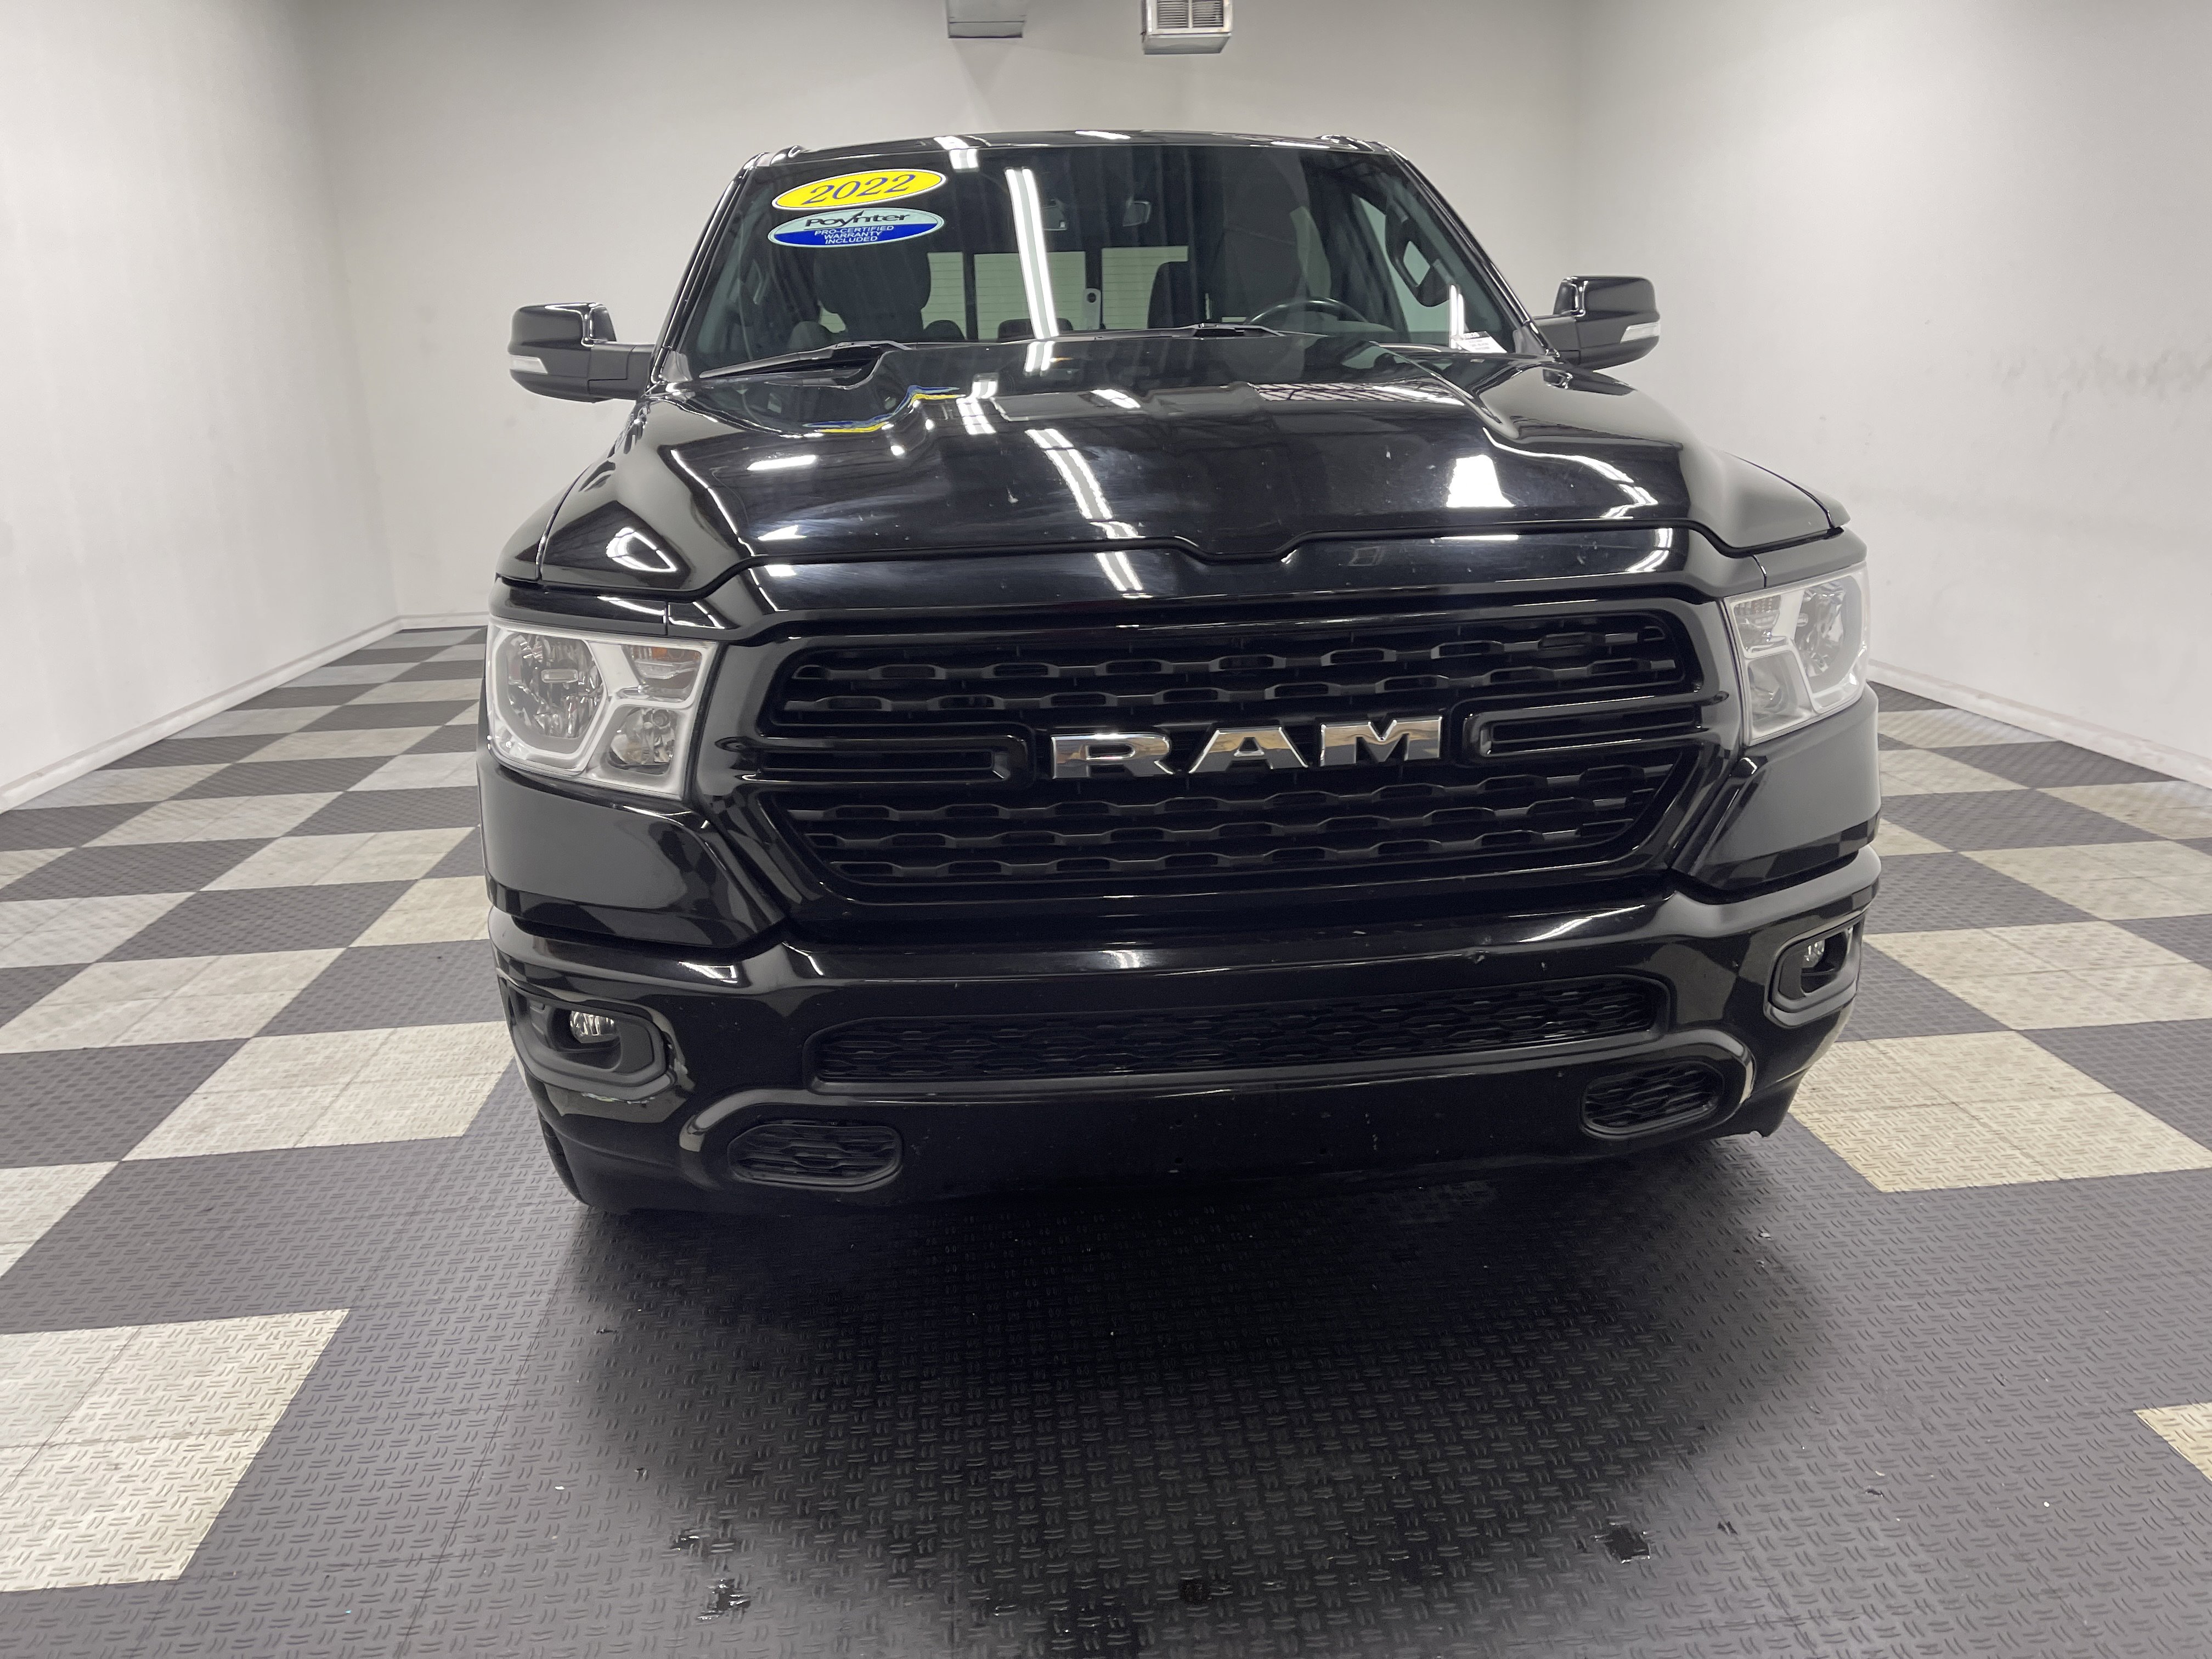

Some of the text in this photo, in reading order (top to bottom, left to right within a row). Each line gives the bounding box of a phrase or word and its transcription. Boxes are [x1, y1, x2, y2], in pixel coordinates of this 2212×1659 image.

[801, 174, 916, 205] 2022
[804, 210, 911, 230] Poynter
[814, 225, 894, 236] PRO-CERTIFIED
[824, 230, 882, 240] WARRANTY
[825, 236, 878, 245] INCLUDED
[1051, 716, 1442, 779] RAM
